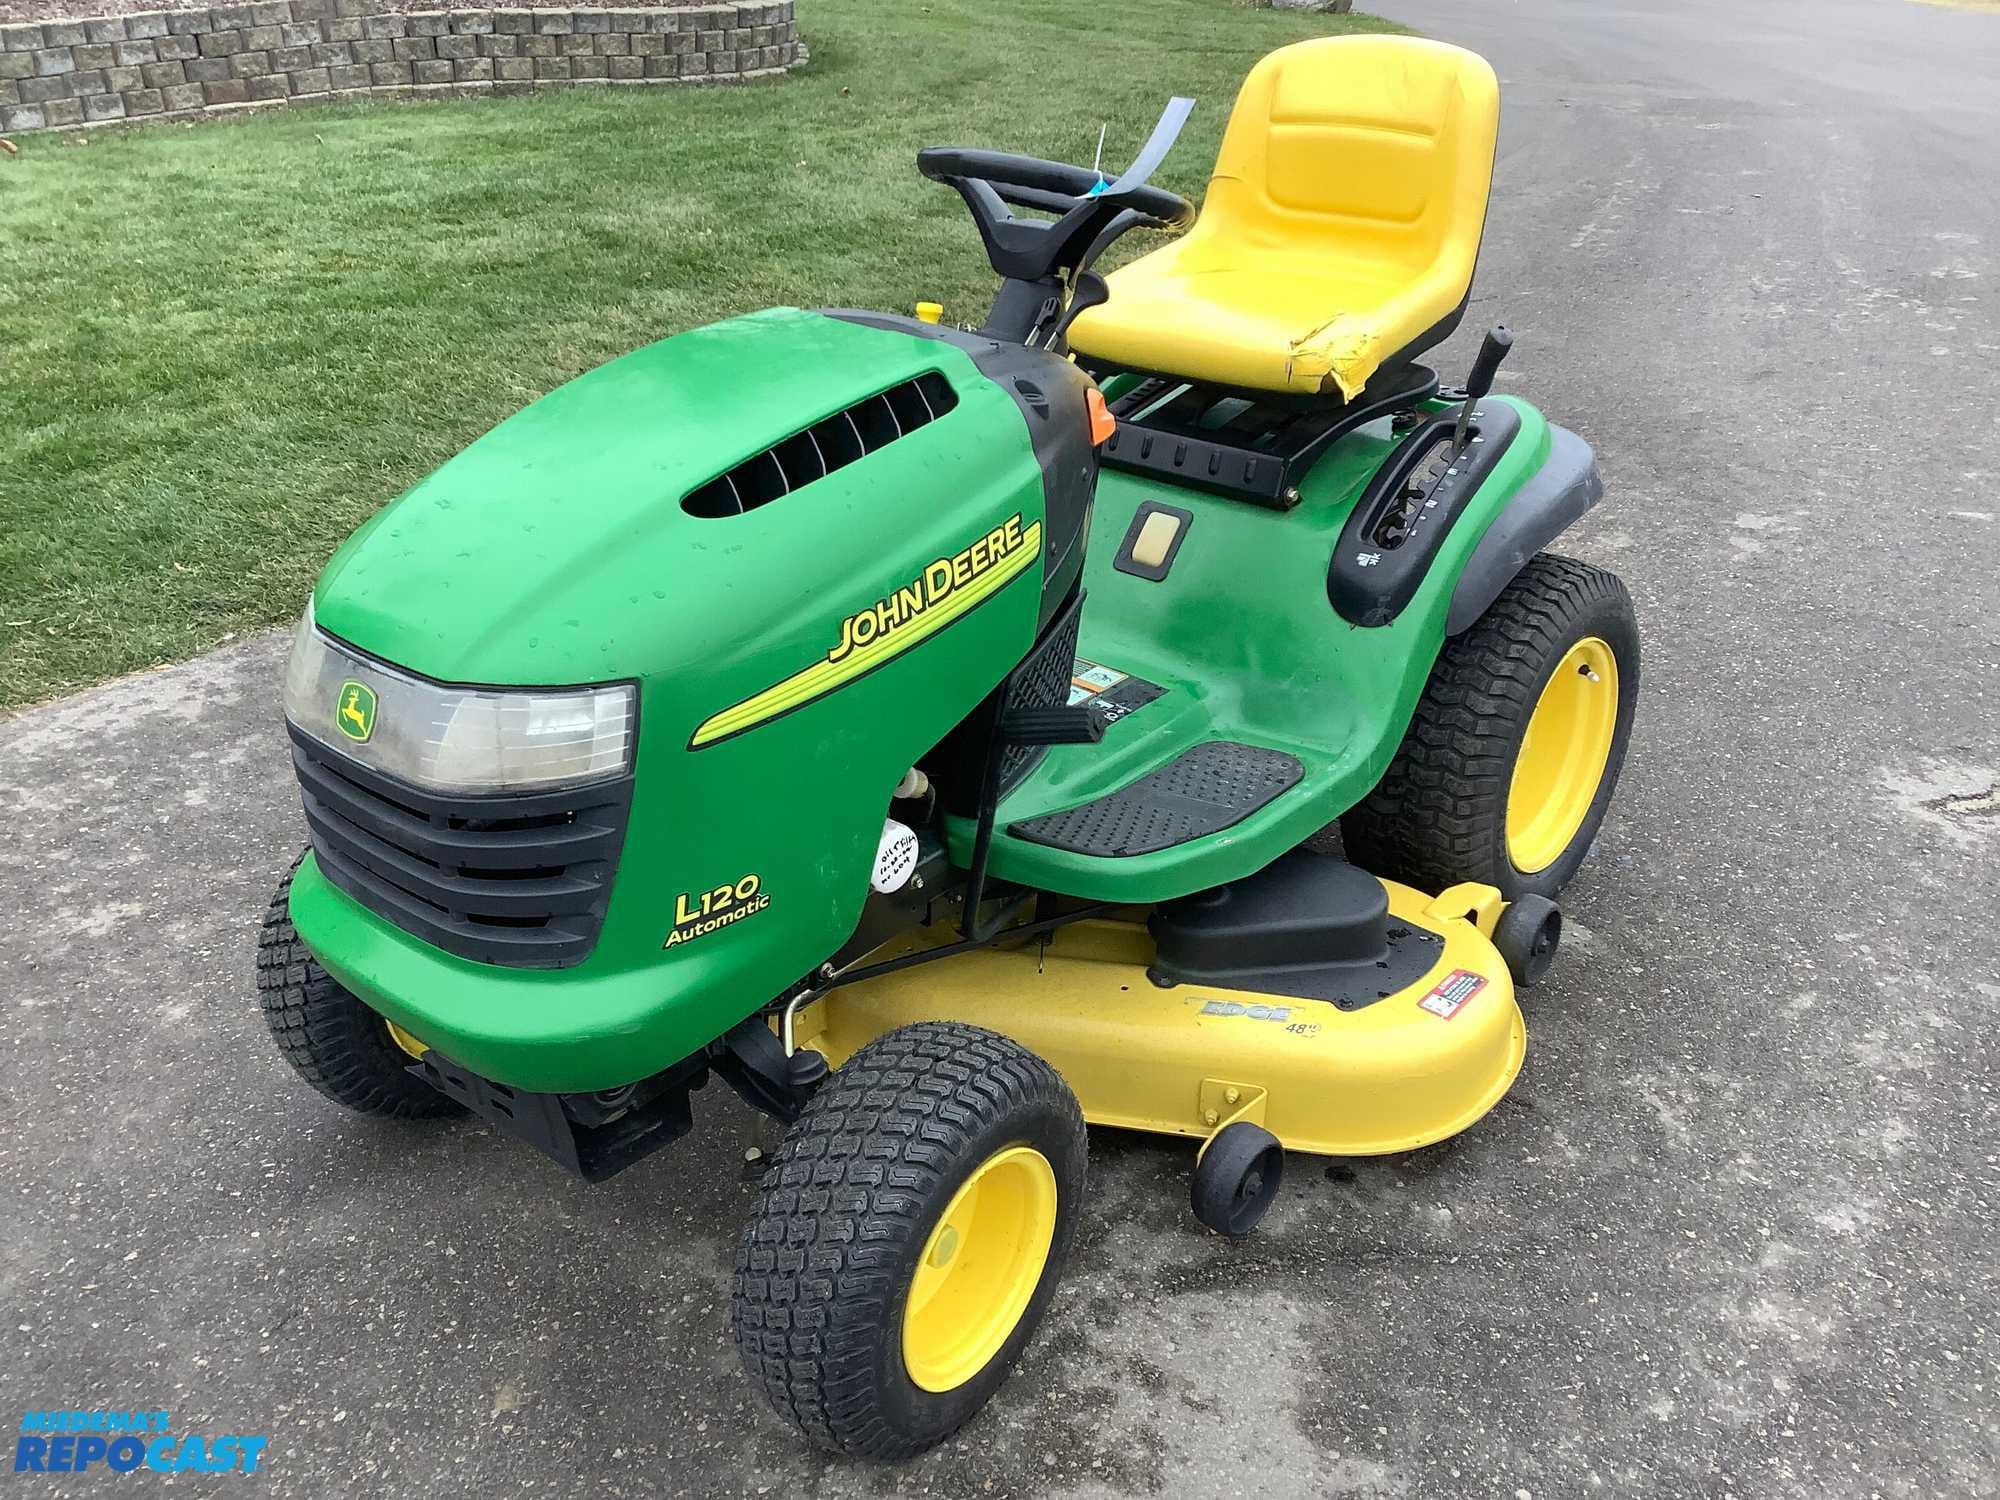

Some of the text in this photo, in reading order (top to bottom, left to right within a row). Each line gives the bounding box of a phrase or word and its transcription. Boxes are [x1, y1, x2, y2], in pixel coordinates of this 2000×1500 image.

[828, 512, 1024, 663] JOHN DEERE
[663, 895, 771, 949] Automatic
[675, 873, 761, 927] L120
